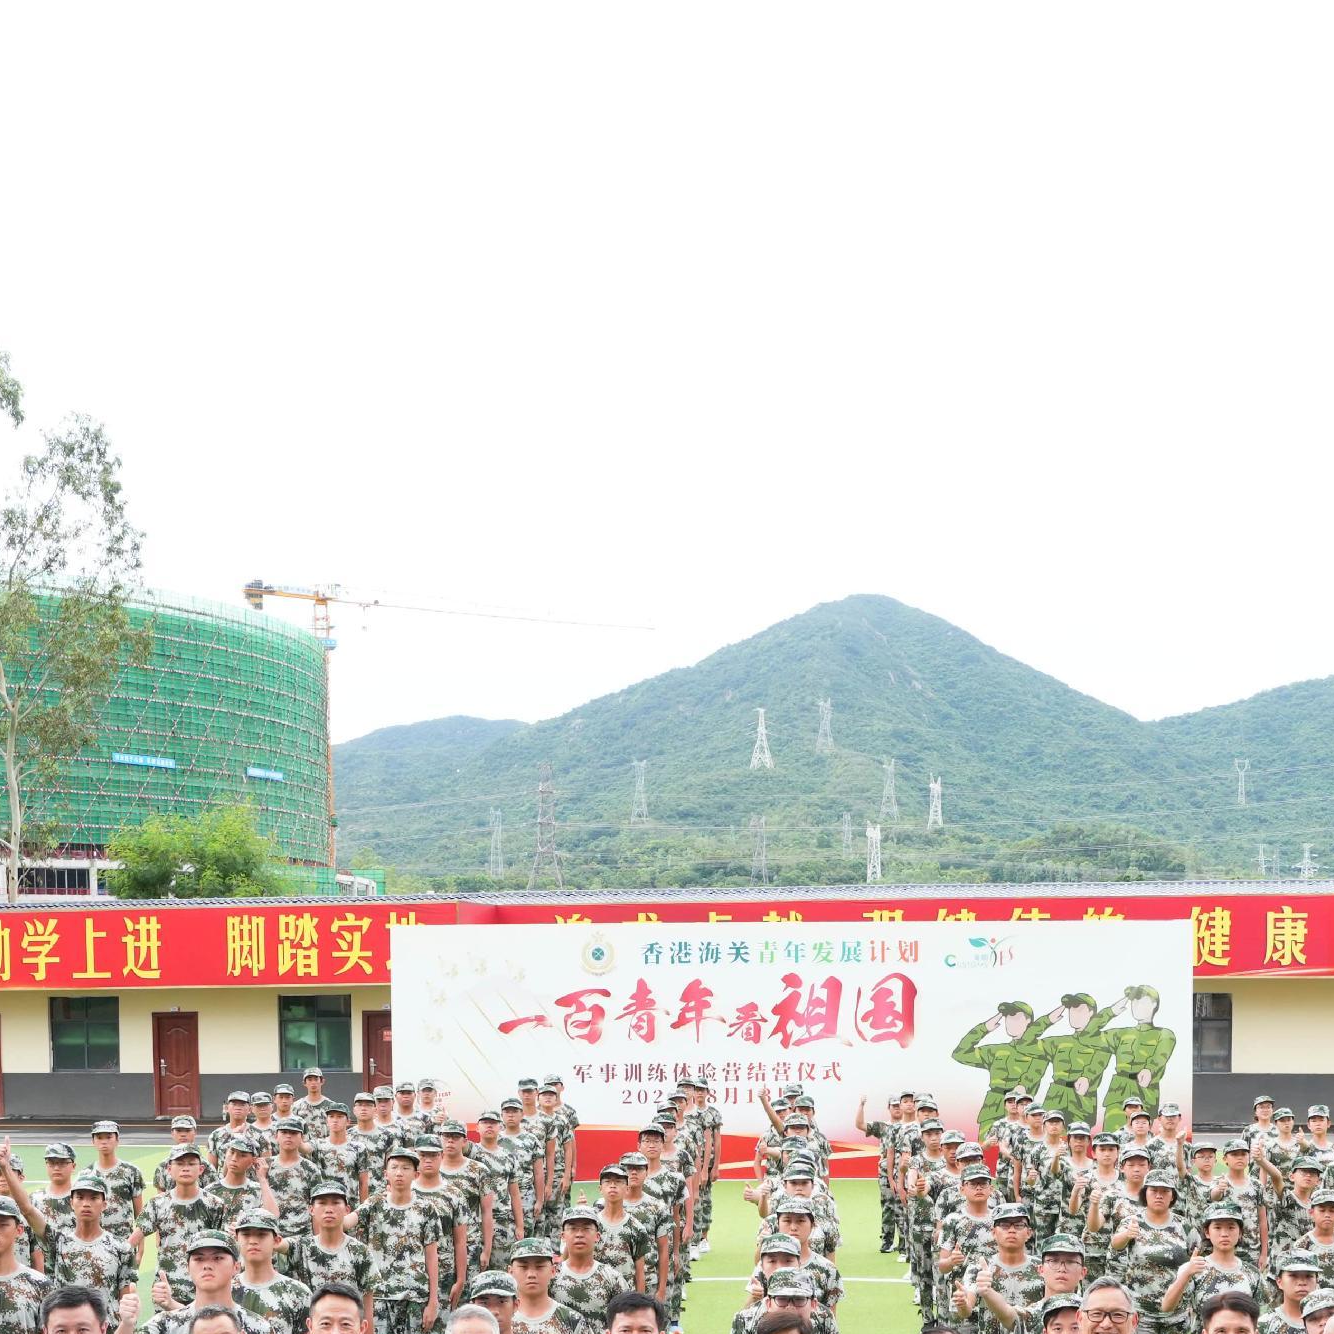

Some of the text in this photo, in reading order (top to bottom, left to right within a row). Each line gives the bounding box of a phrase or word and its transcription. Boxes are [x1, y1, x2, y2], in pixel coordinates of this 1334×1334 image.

[226, 911, 424, 977] 脚踏实
[641, 940, 921, 965] 香港海关青年发展计划
[498, 973, 918, 1048] 一百青年看祖国
[573, 1061, 842, 1083] 军事训练体验营结营仪式
